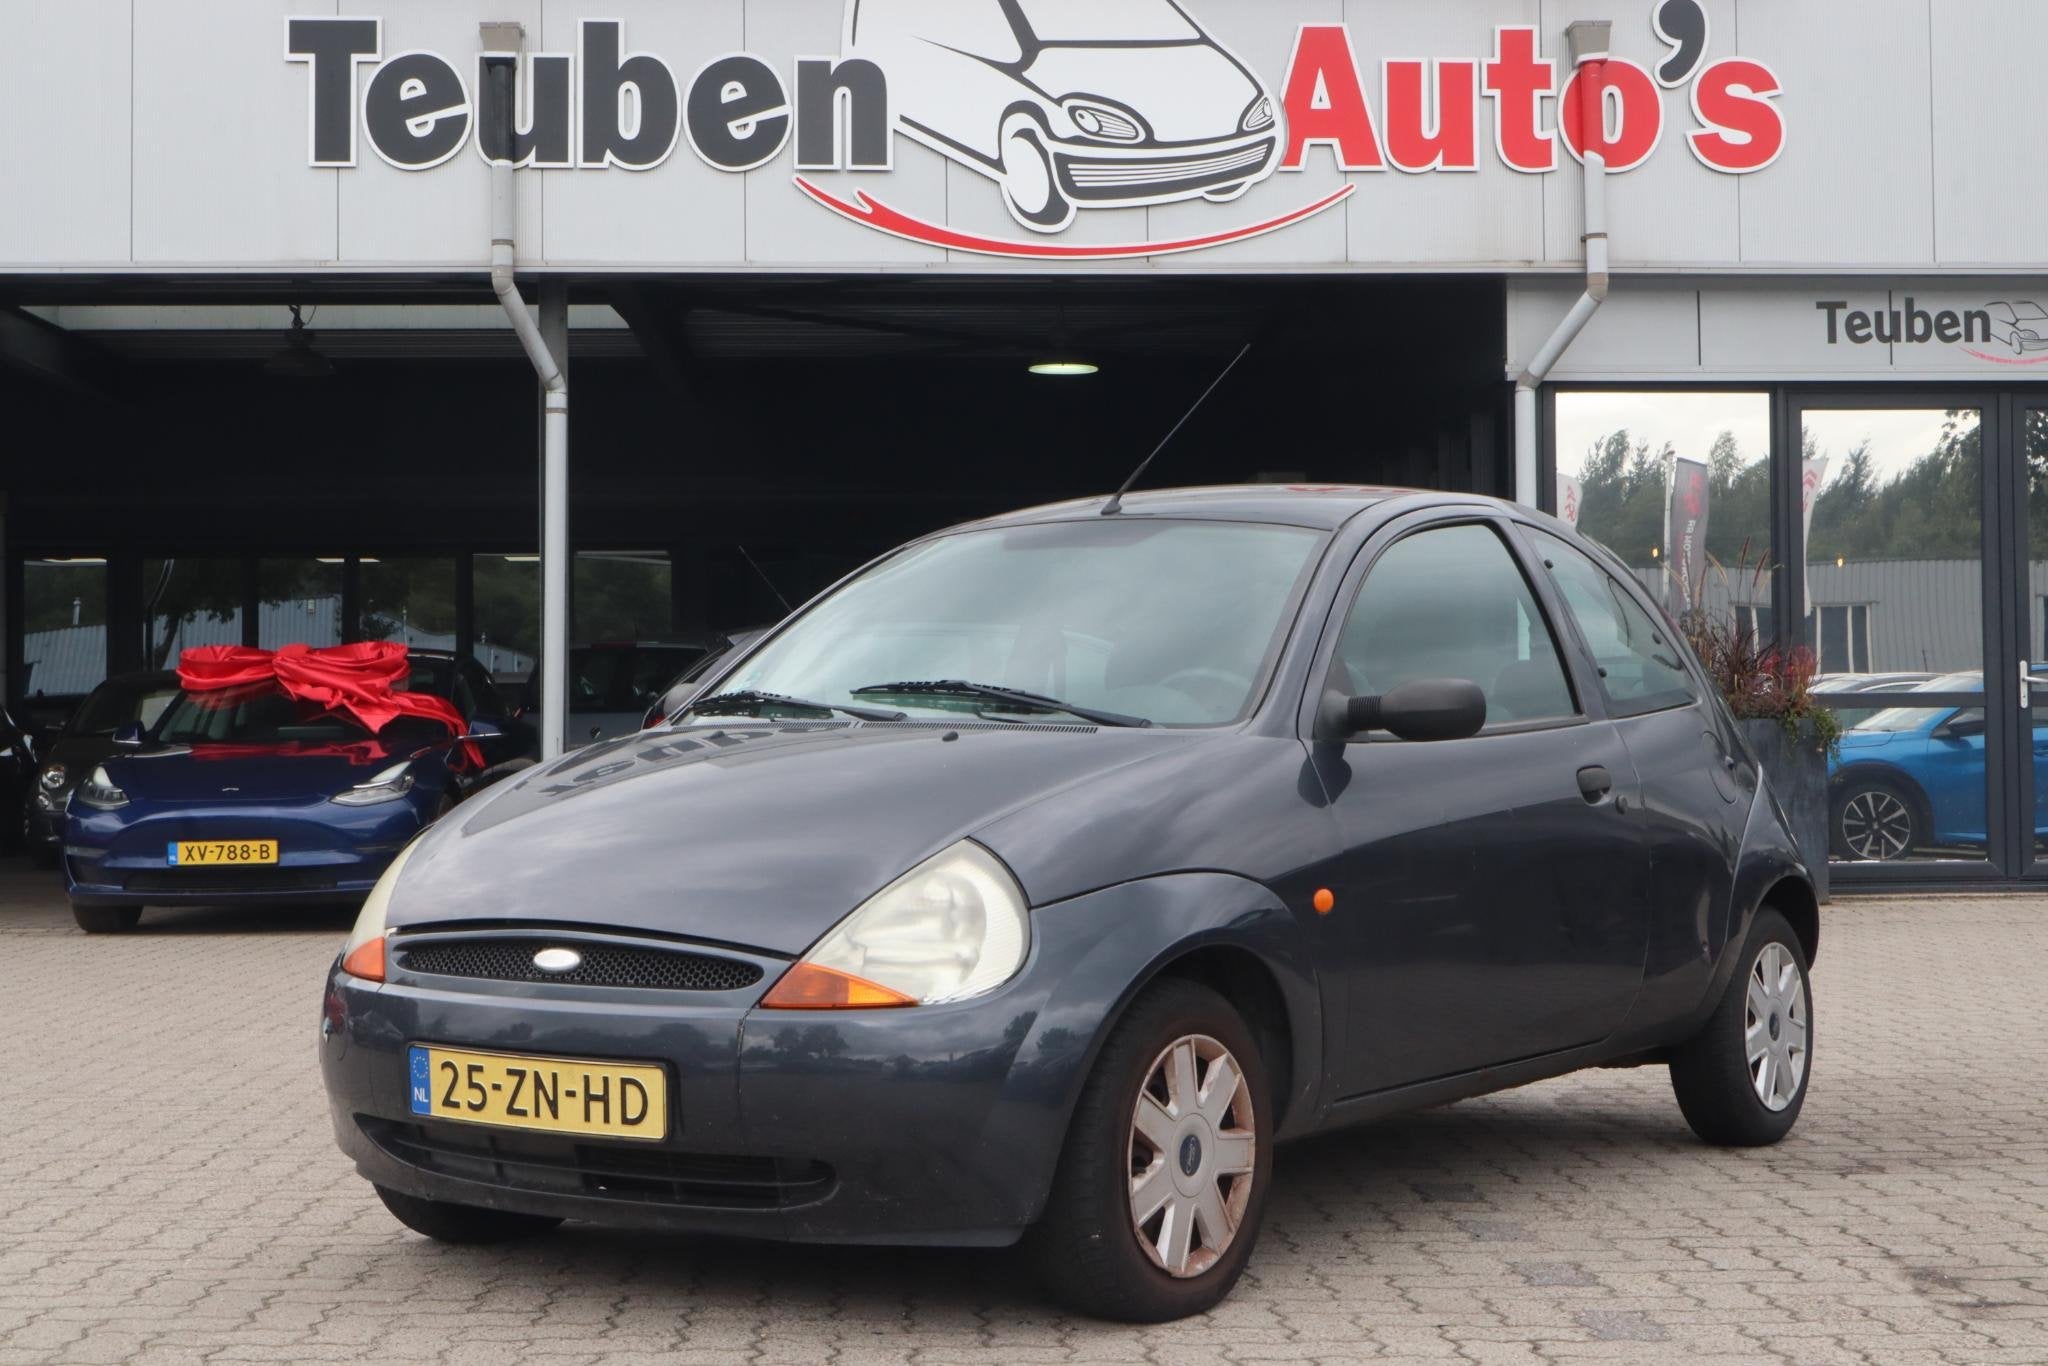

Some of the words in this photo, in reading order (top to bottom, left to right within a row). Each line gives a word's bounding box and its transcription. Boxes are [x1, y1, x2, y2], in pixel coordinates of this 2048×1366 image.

[286, 17, 892, 170] Teuben
[1280, 0, 1785, 172] Auto's
[1815, 297, 1991, 344] Teuben
[185, 844, 270, 861] XV-788-B
[414, 1086, 429, 1103] NL
[440, 1060, 649, 1126] 25-ZN-HD
